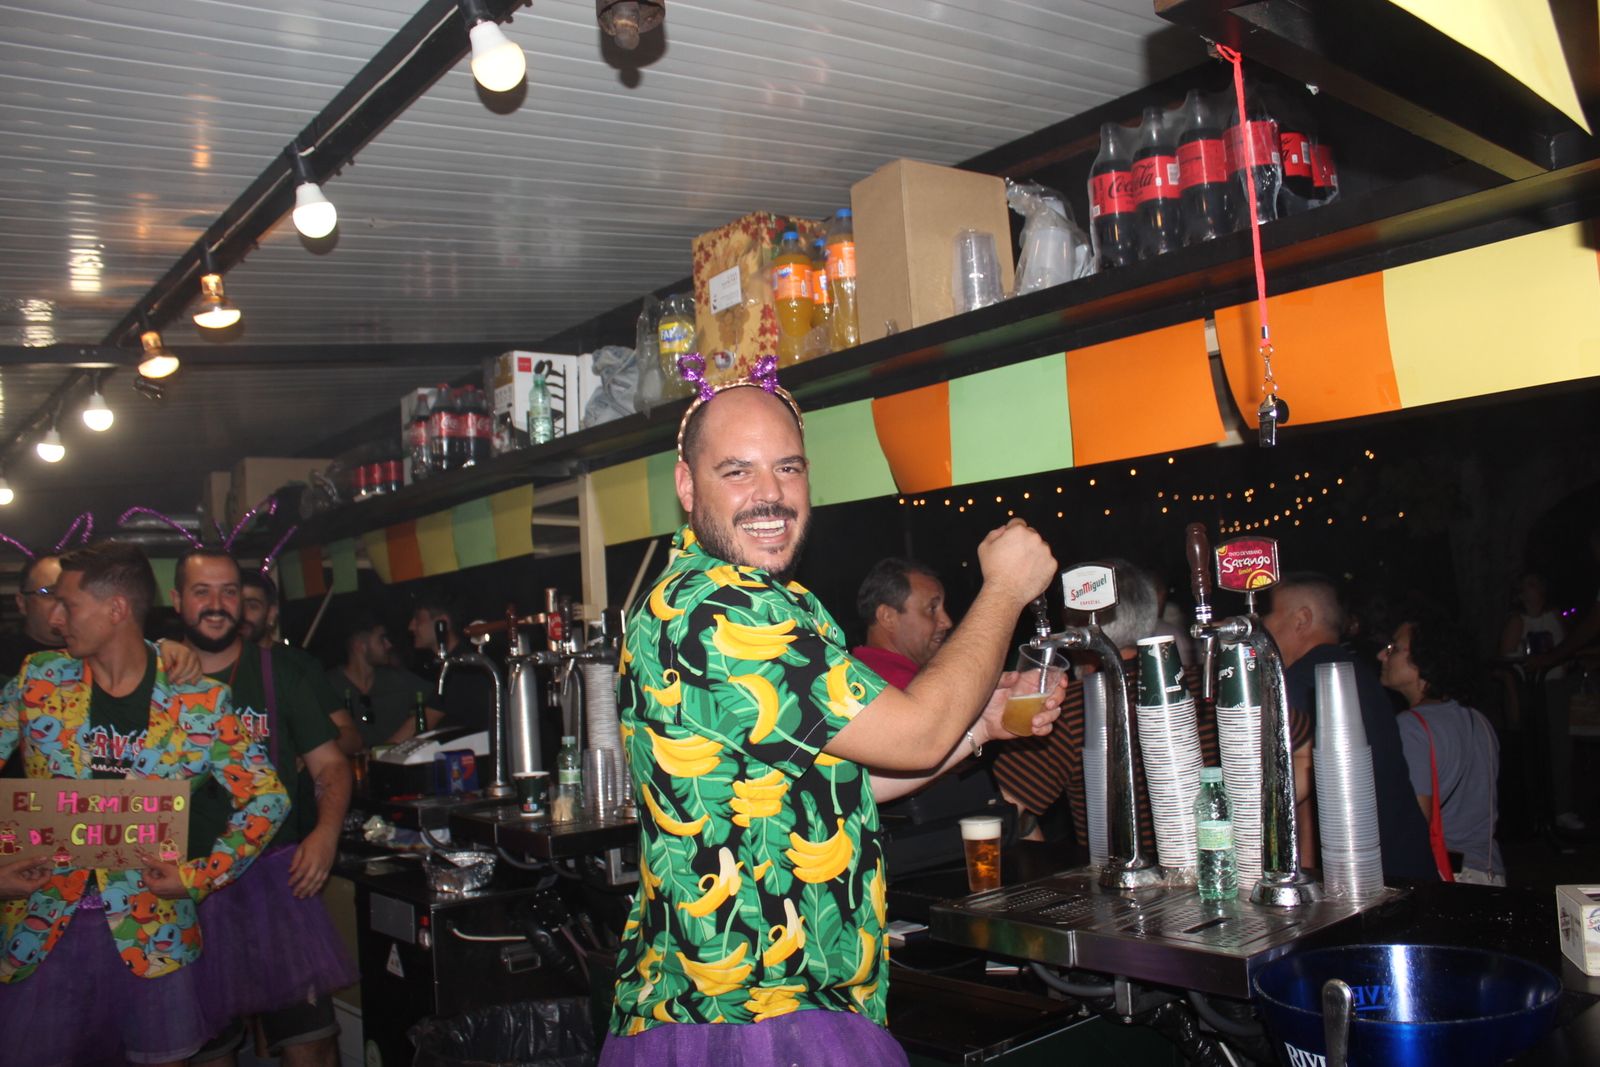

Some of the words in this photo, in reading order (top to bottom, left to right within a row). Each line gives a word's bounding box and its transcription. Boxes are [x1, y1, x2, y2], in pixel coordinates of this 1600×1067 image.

[1221, 556, 1271, 574] Sarango
[12, 791, 42, 812] EL
[56, 790, 185, 815] HORMIGUEO
[28, 827, 55, 846] DE
